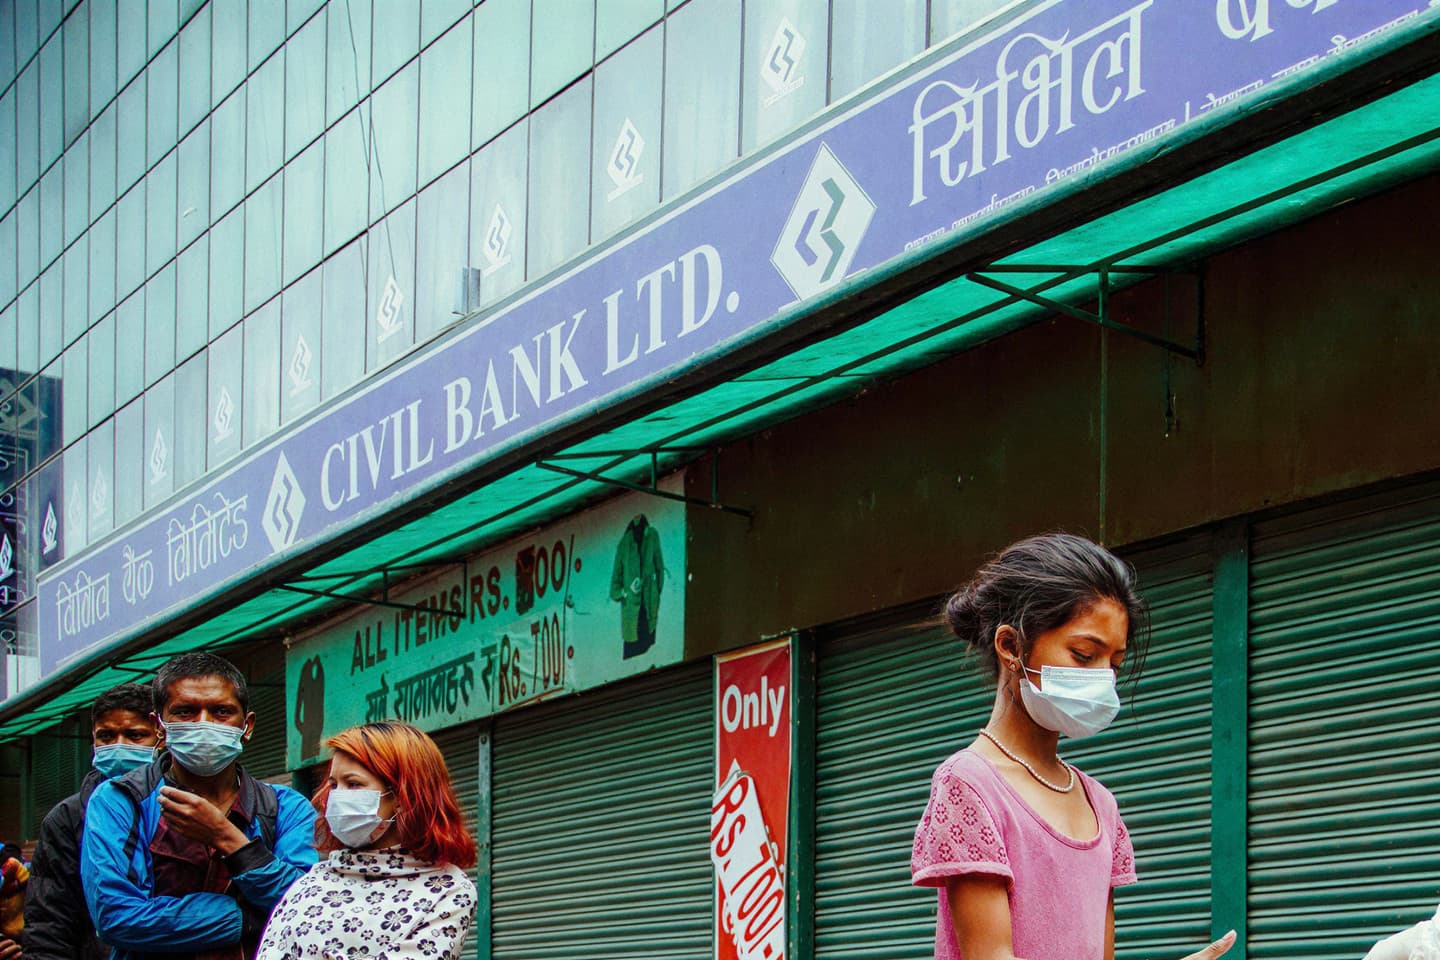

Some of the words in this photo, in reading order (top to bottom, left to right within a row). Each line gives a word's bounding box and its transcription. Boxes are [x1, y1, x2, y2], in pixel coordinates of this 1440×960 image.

[320, 399, 435, 512] CIVIL
[443, 309, 589, 454] BANK
[602, 244, 740, 376] LTD.
[350, 621, 387, 676] ALL
[394, 583, 462, 657] ITEMS
[470, 566, 509, 624] RS.
[722, 675, 785, 737] Only
